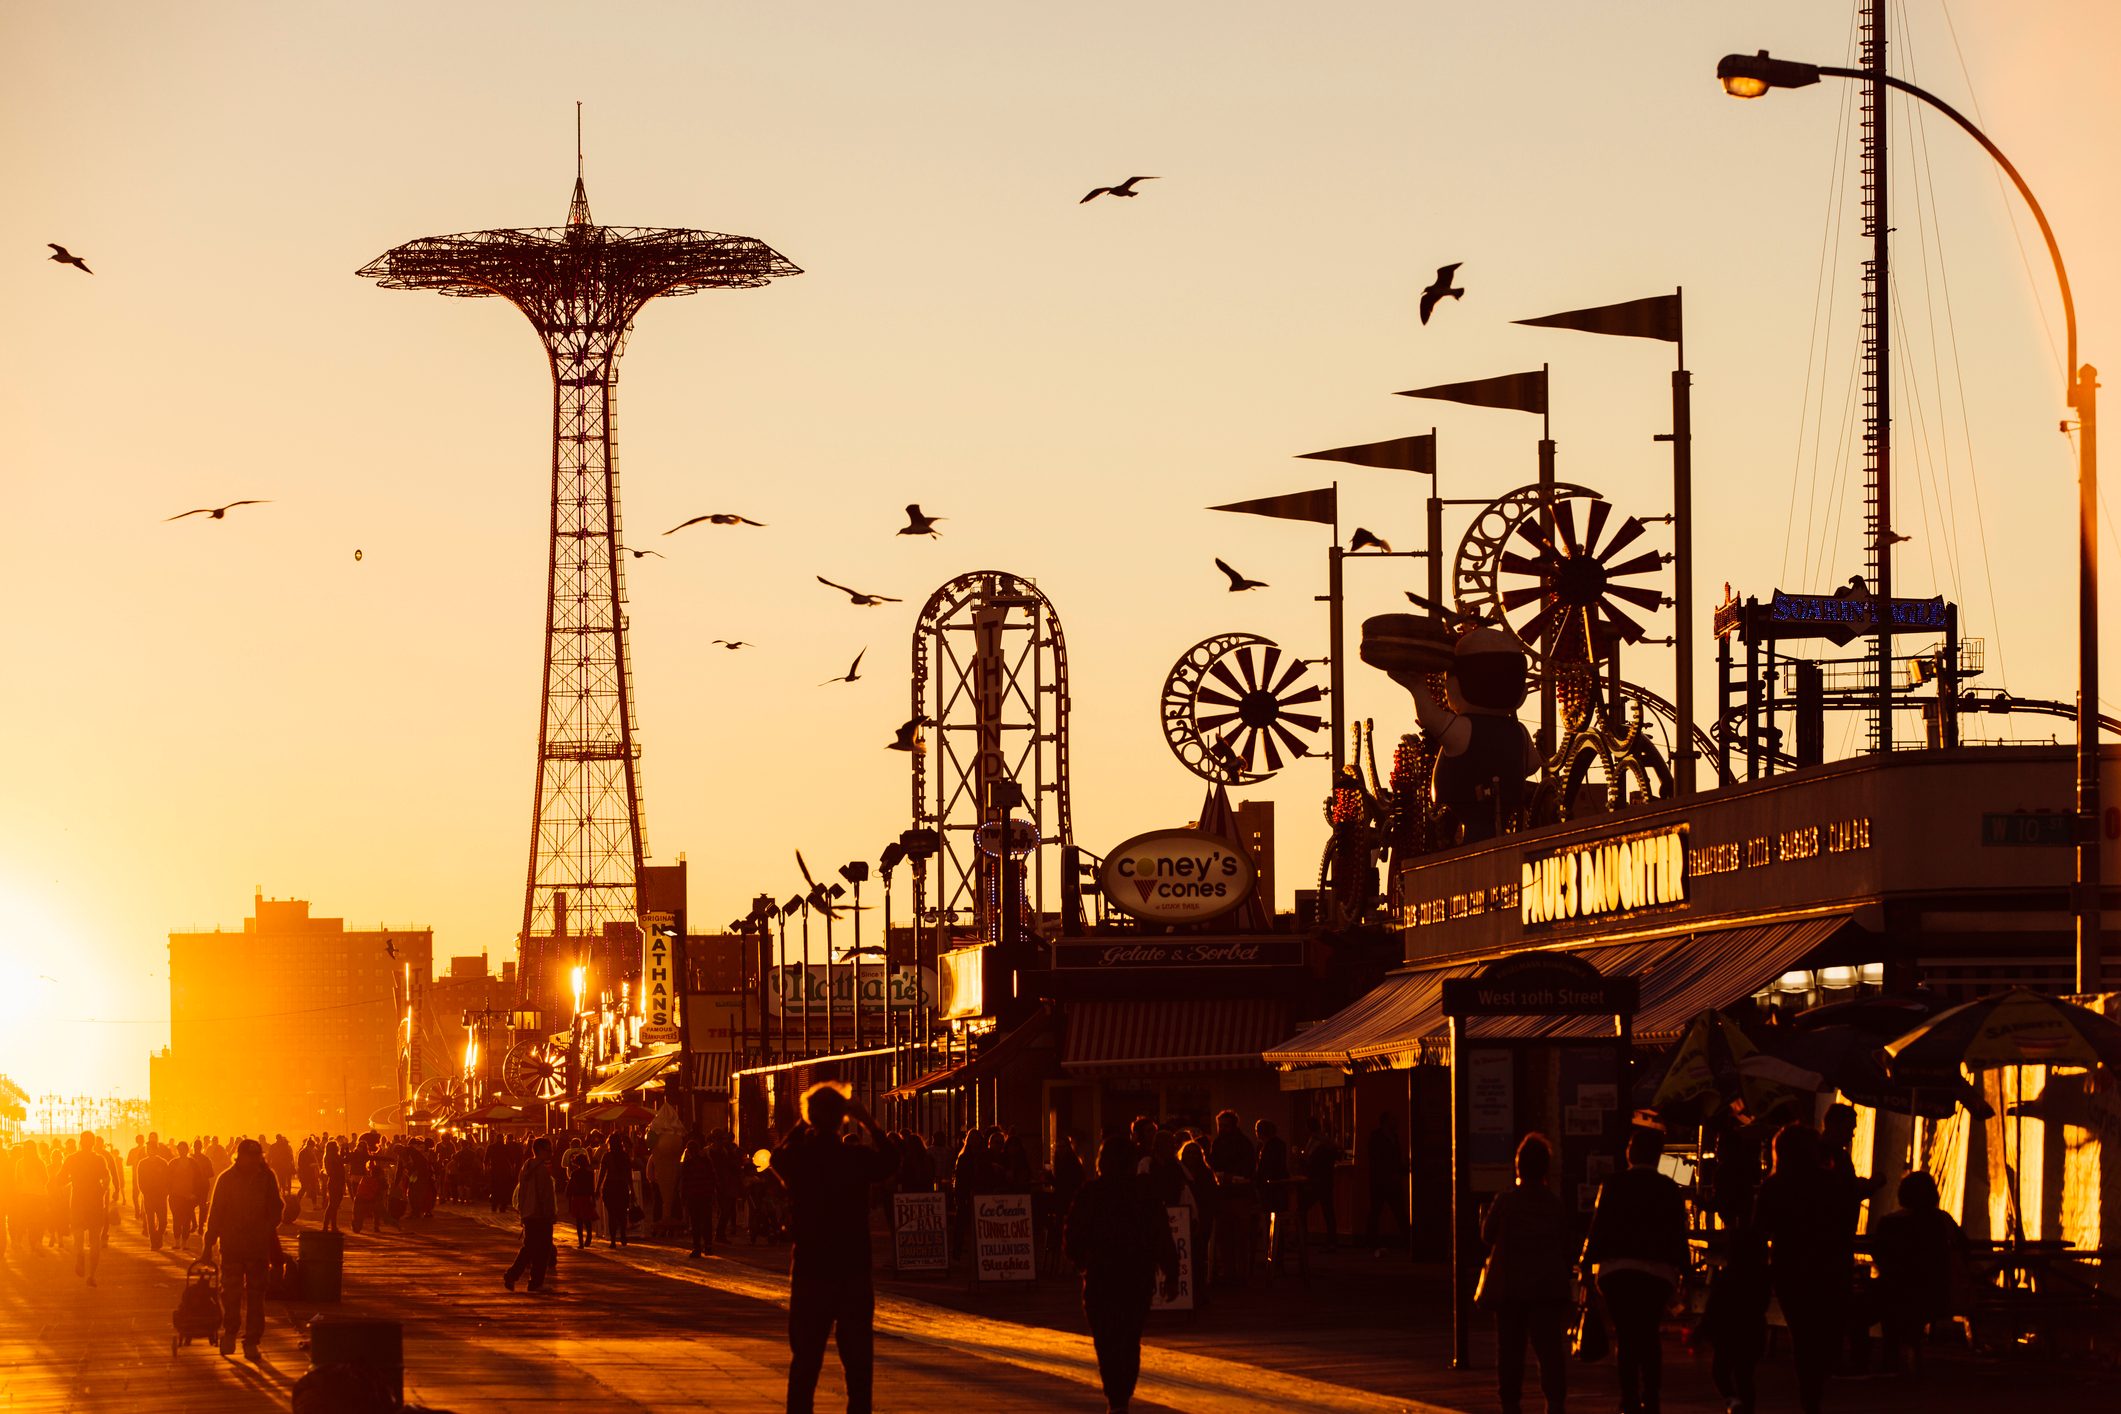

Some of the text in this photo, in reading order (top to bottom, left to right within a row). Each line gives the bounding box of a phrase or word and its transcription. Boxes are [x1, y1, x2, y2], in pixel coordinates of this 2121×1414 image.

[983, 828, 1016, 839] TWT
[1118, 851, 1238, 881] coney's
[1158, 881, 1227, 898] cones
[1522, 833, 1684, 925] PAUL'S DAUGHTER
[1098, 943, 1261, 966] Gelato & Sorbet
[652, 923, 667, 1026] NATHANS
[1477, 988, 1605, 1005] West 10th Street
[896, 1204, 935, 1231] BEER
[917, 1216, 944, 1231] BAR
[977, 1218, 1031, 1240] FUNNEL CAKE
[981, 1243, 1013, 1256] ITALIAN
